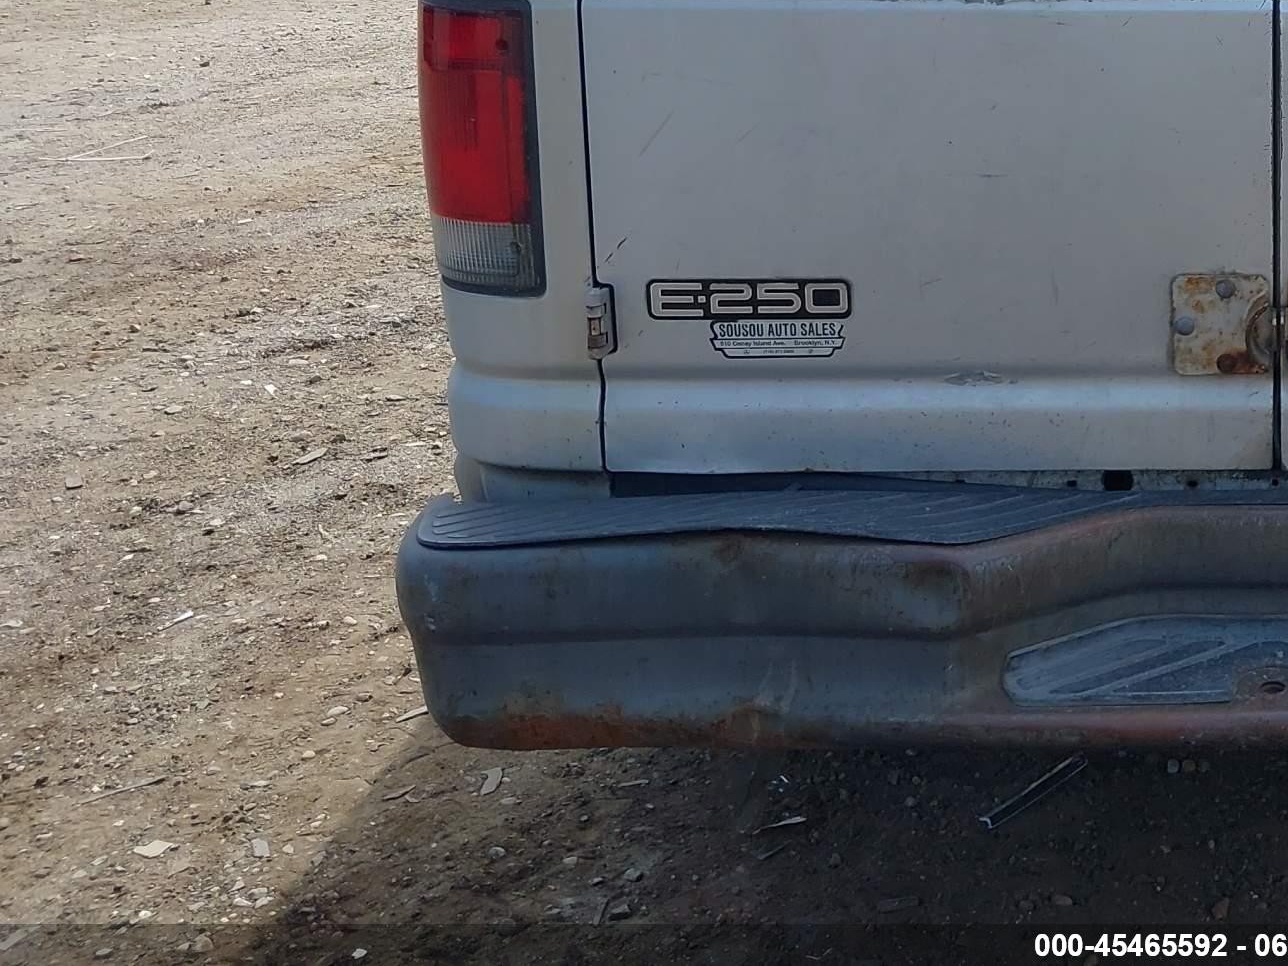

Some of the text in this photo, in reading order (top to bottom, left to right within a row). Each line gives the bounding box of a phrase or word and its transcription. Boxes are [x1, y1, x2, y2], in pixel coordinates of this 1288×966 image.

[718, 323, 836, 338] SOUSOU AUTO SALES
